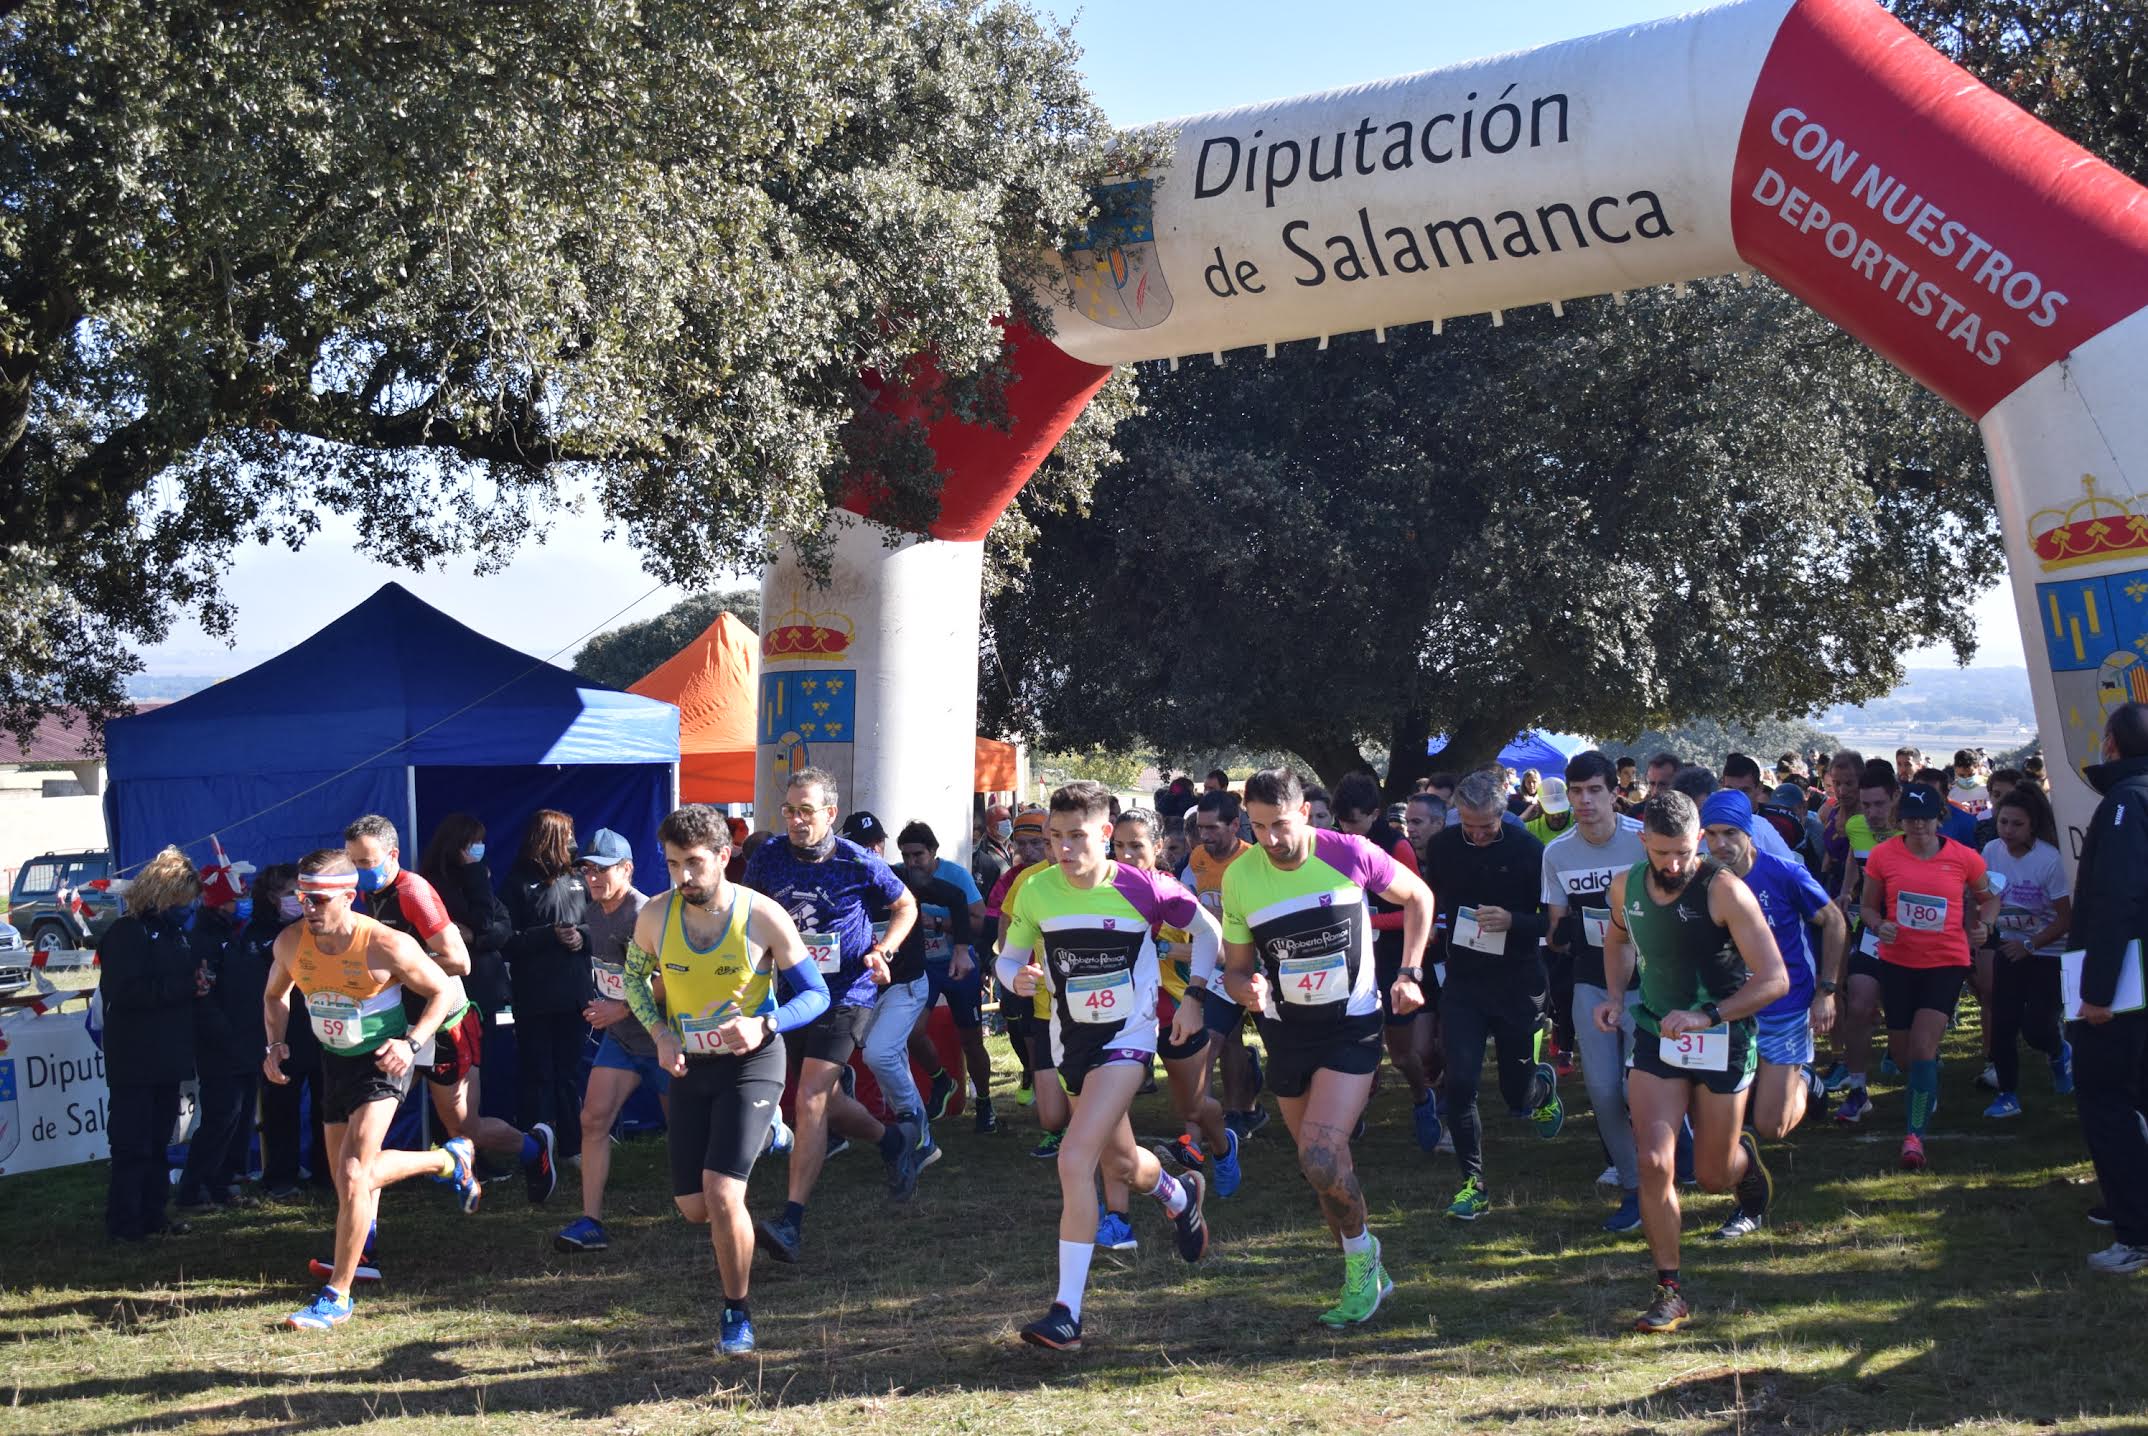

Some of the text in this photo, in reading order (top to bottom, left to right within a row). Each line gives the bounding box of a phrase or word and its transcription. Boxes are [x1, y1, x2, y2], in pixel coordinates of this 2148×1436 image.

[1194, 83, 1570, 208] Diputación
[1771, 107, 2069, 328] CON NUESTROS
[1204, 189, 1674, 299] de Salamanca
[1751, 167, 2011, 366] DEPORTISTAS
[1568, 870, 1613, 891] adid
[1904, 903, 1938, 922] 180
[1286, 937, 1323, 951] Roberto
[1297, 971, 1327, 991] 47
[1085, 989, 1116, 1009] 48
[323, 1019, 344, 1036] 59
[1677, 1034, 1704, 1054] 31
[26, 1050, 105, 1092] Diput
[32, 1098, 107, 1142] de Sal
